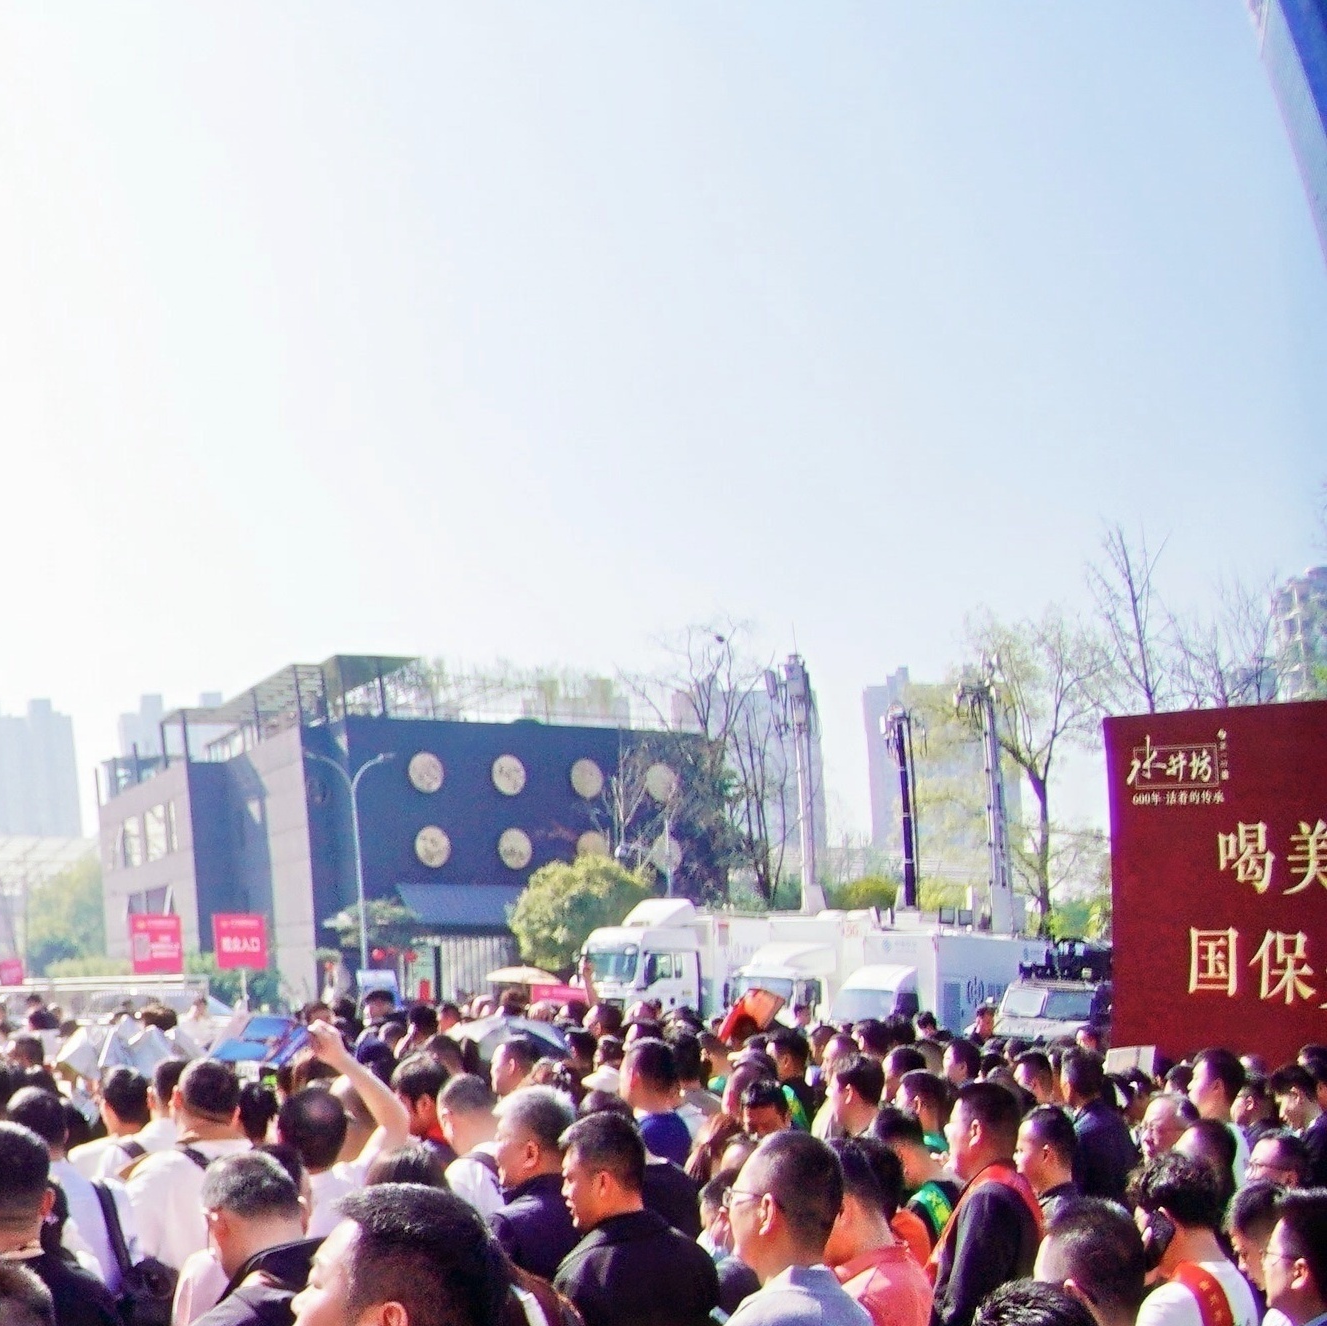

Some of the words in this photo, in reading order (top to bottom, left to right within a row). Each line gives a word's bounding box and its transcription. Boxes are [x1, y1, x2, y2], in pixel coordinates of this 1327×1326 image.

[1126, 734, 1213, 786] 水井坊
[1216, 818, 1327, 895] 喝美
[1188, 925, 1327, 1010] 国保
